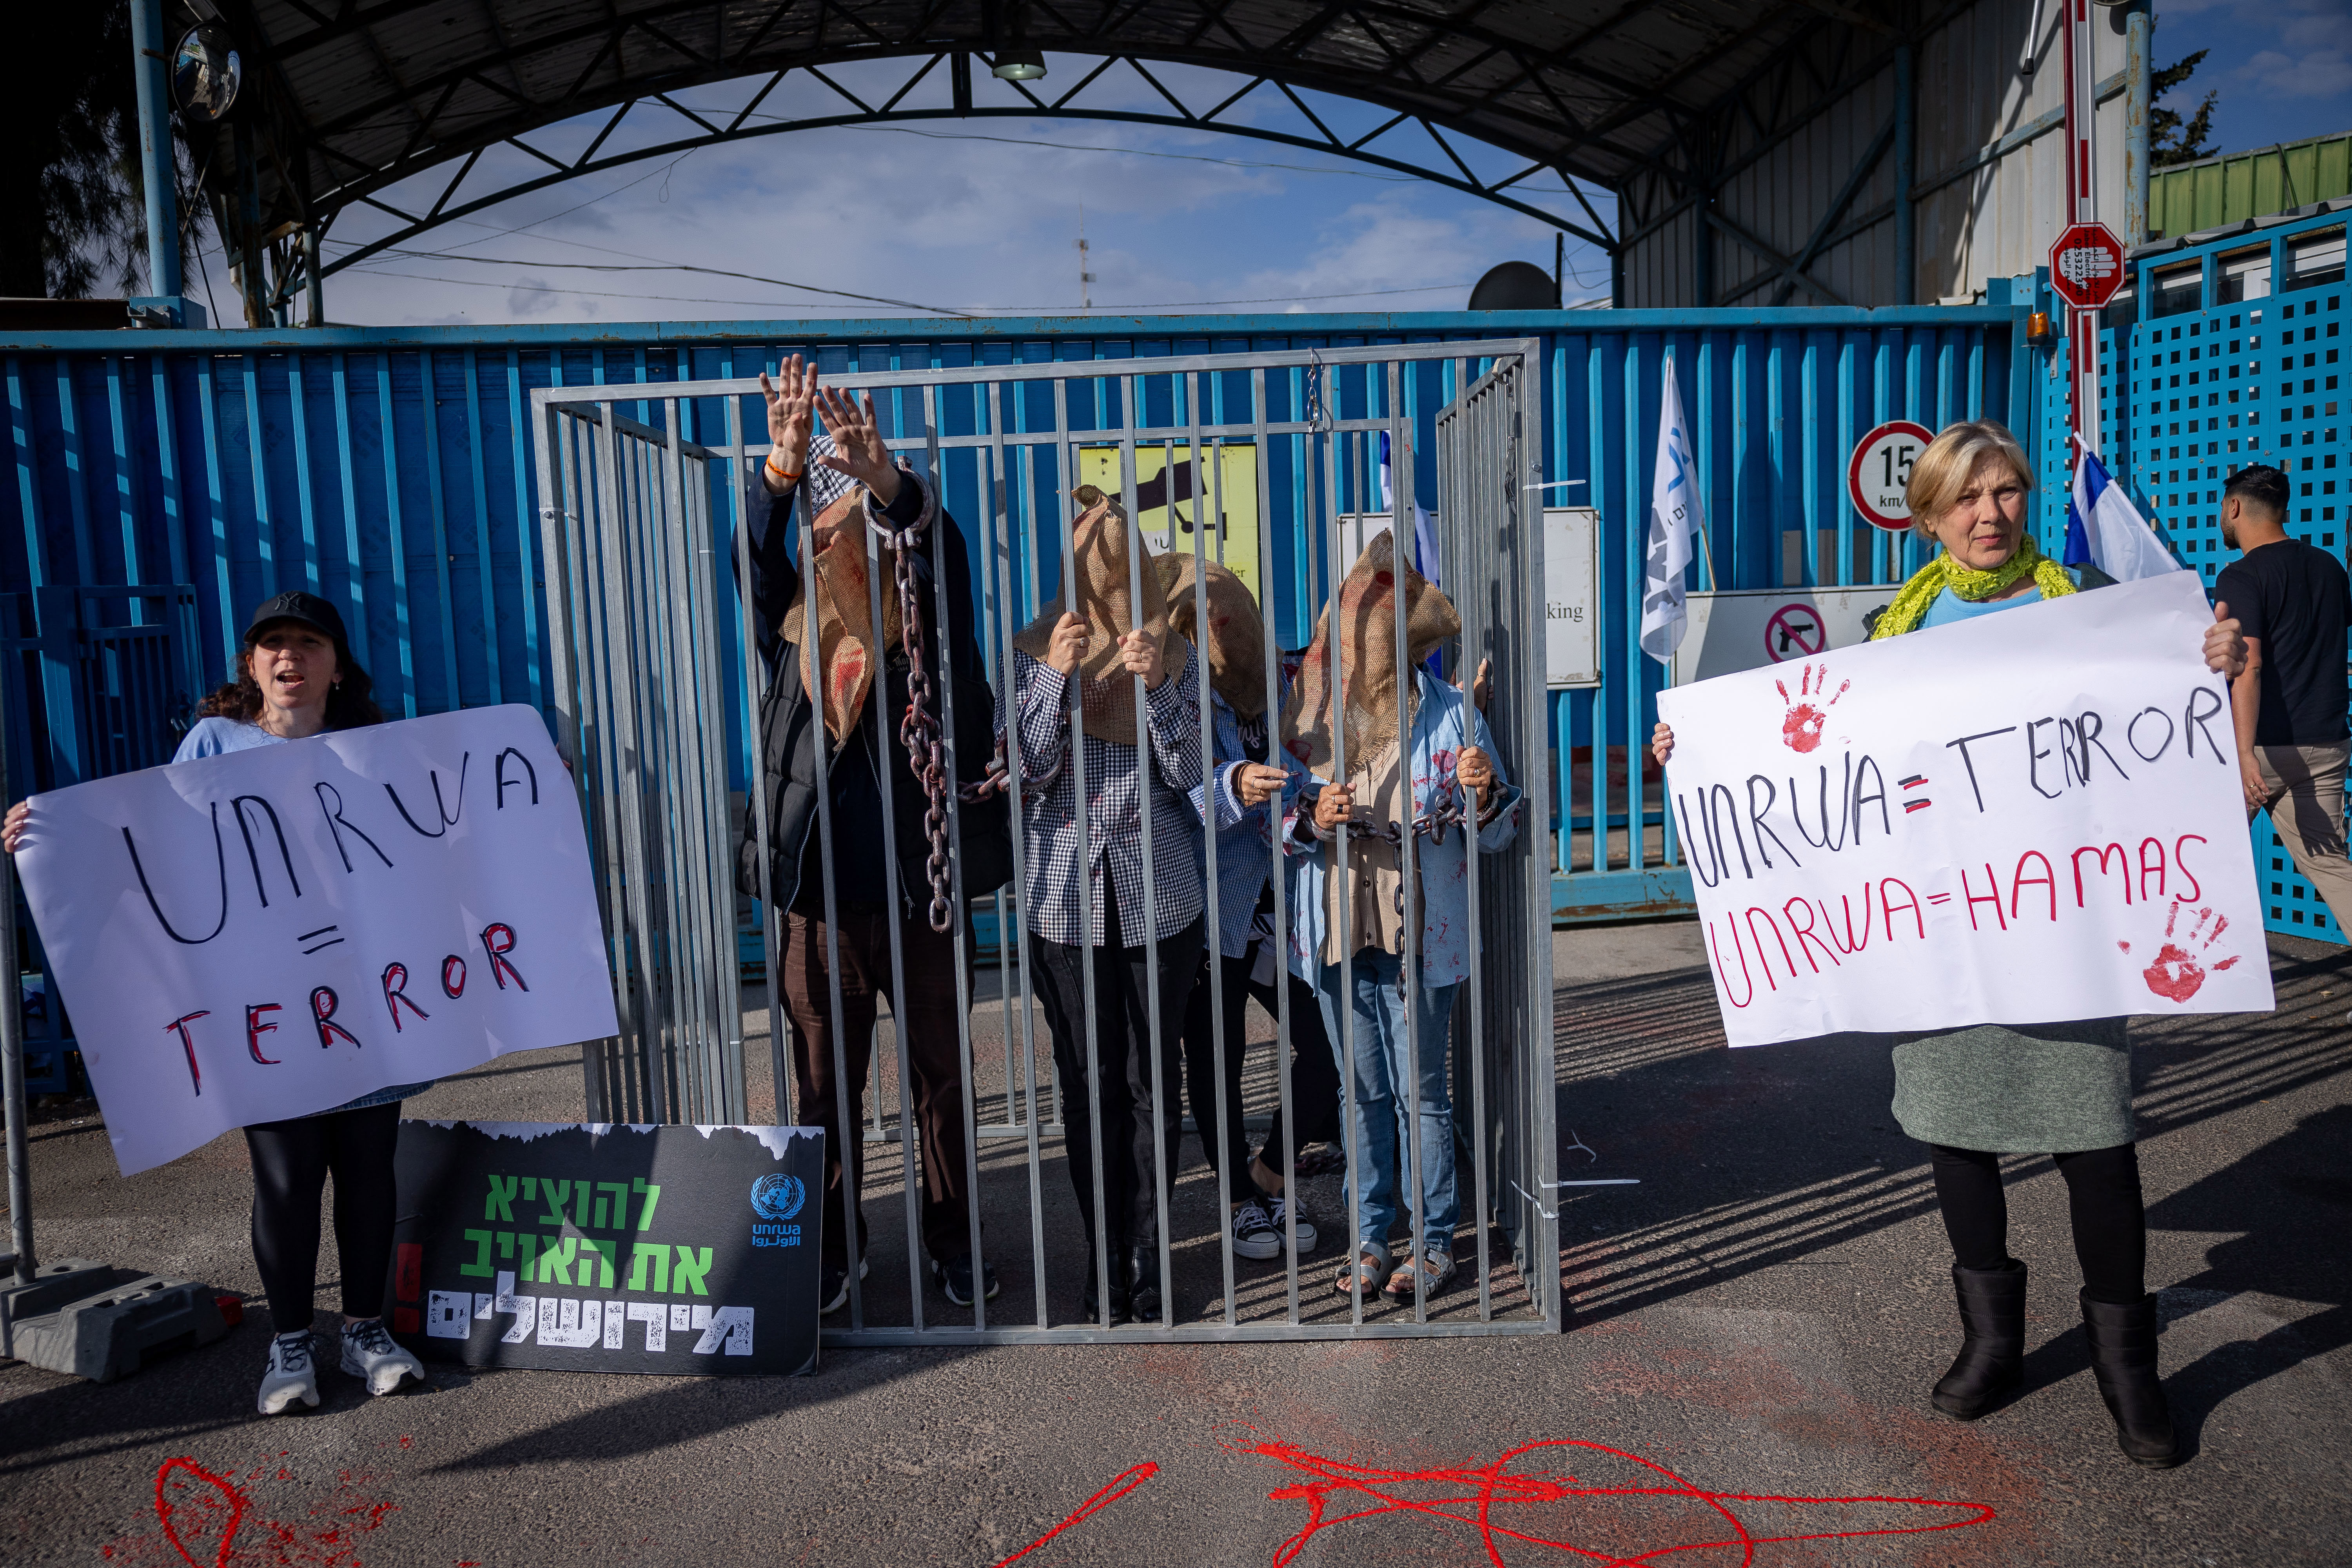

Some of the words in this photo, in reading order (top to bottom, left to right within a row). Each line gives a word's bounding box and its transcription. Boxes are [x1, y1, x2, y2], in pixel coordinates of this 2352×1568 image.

[2074, 238, 2083, 296] 025322380
[1881, 445, 1915, 487] 15
[1880, 494, 1906, 508] km/
[1546, 603, 1584, 622] king
[162, 922, 530, 1098] TERROR
[485, 1174, 661, 1231] להוציא
[753, 1224, 800, 1235] unrwa
[460, 1229, 616, 1289] האויב
[628, 1242, 713, 1296] את
